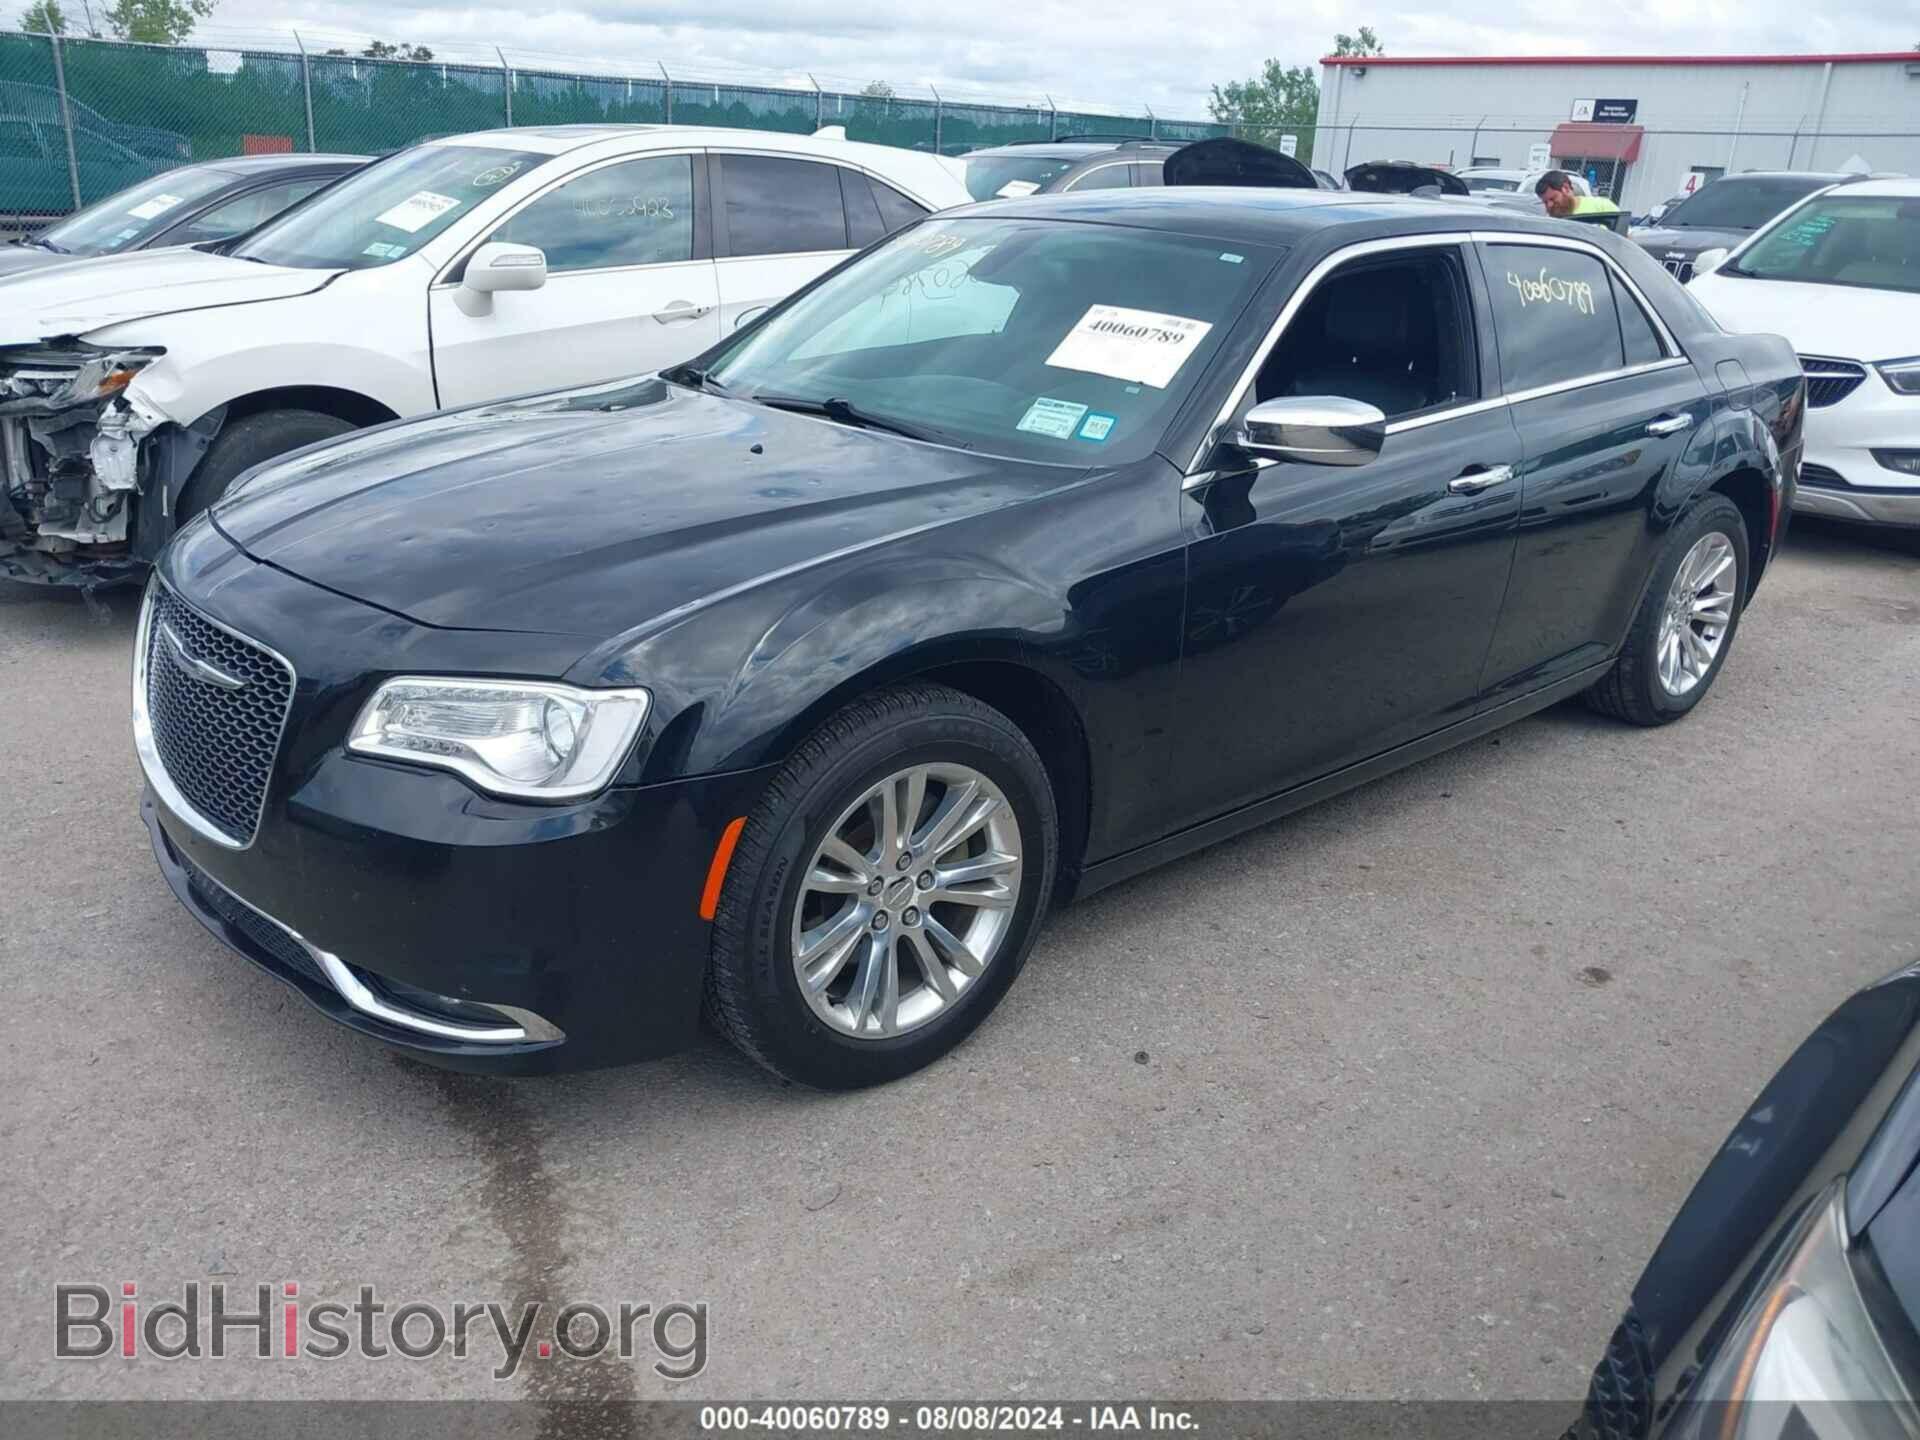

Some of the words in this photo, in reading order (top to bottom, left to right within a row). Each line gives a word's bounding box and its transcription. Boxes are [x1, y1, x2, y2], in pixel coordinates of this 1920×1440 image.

[1685, 175, 1697, 194] 4
[1507, 267, 1595, 315] 40060789
[1089, 319, 1185, 345] 40060789
